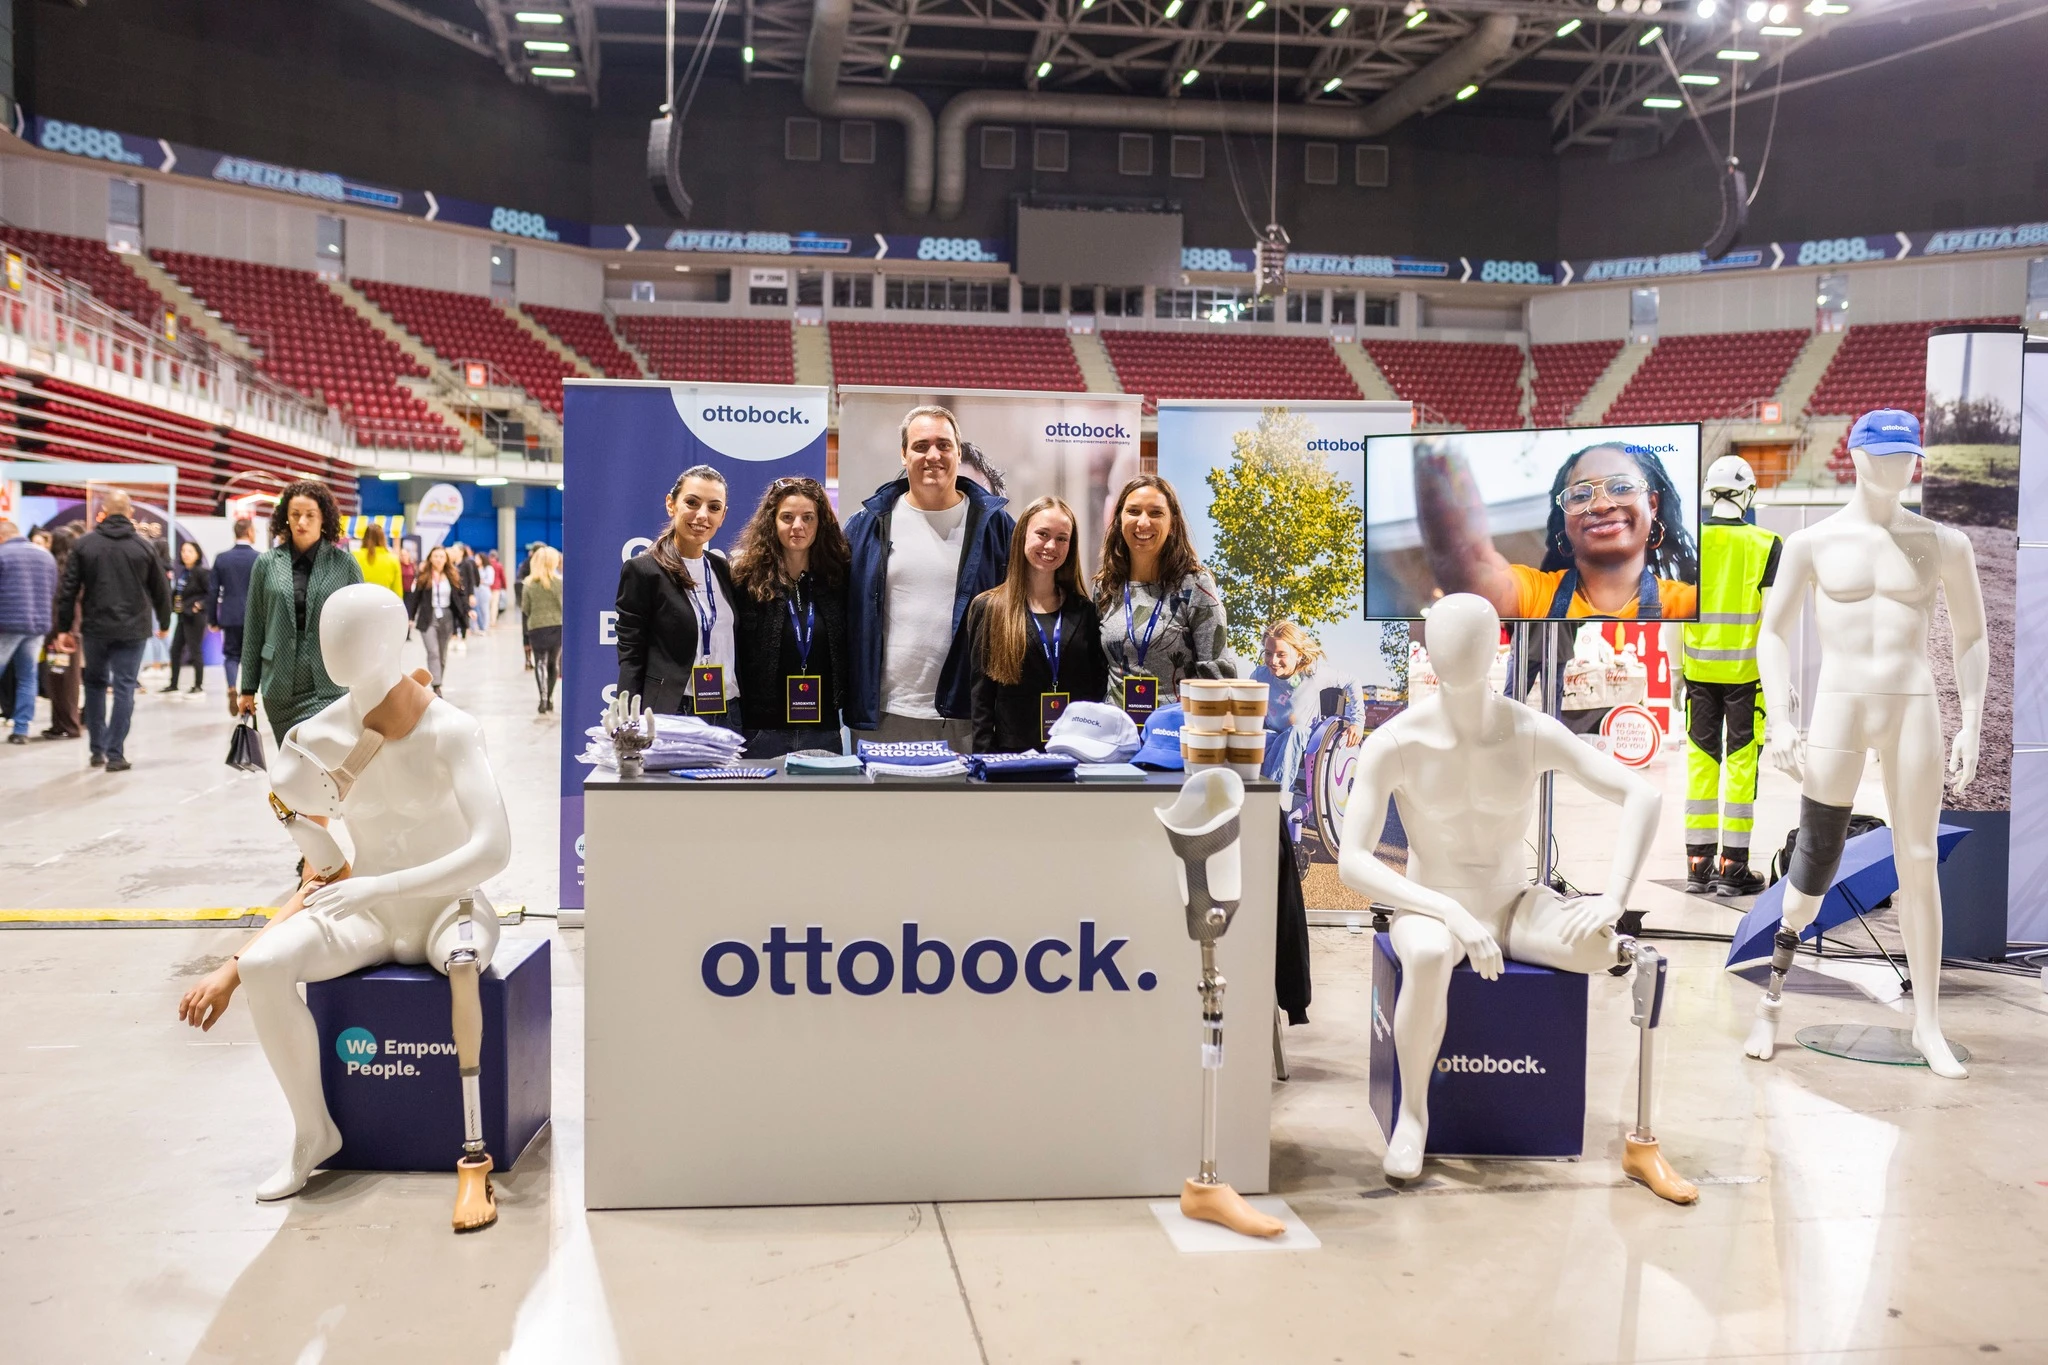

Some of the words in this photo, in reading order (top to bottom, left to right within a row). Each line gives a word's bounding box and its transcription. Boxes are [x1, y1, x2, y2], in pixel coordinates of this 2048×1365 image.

[668, 231, 743, 250] АРЕНА
[744, 231, 792, 253] 8888
[1926, 230, 2014, 254] АРЕНА
[1285, 255, 1350, 275] АРЕНА
[1352, 256, 1394, 277] 8888
[1584, 257, 1655, 281] АРЕНА
[1656, 252, 1702, 276] 8888
[702, 405, 810, 425] ottobock.
[1045, 422, 1131, 439] ottobock.
[1881, 425, 1912, 433] ottobock.
[1625, 443, 1679, 454] ottobock.
[701, 919, 1158, 997] ottobock.
[346, 1039, 378, 1055] We
[347, 1060, 421, 1080] People.
[1437, 1054, 1547, 1074] ottobock.
